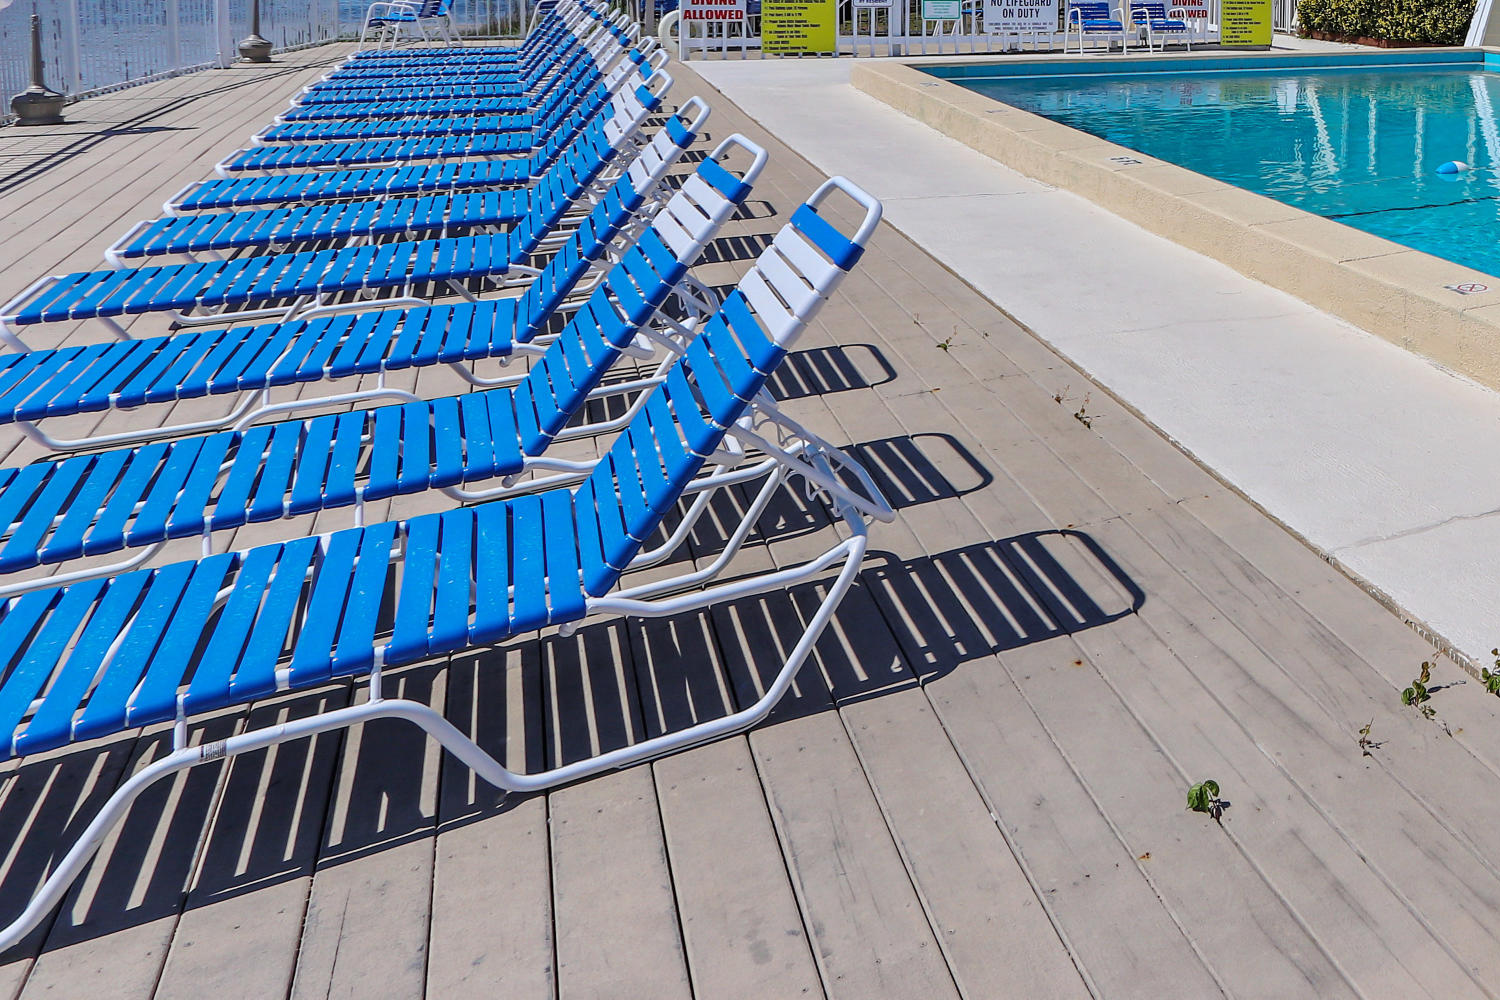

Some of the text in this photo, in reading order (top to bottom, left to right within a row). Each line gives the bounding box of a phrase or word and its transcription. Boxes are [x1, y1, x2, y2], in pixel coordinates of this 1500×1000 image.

[683, 9, 744, 20] ALLOWED
[1002, 8, 1040, 18] ON DUTY
